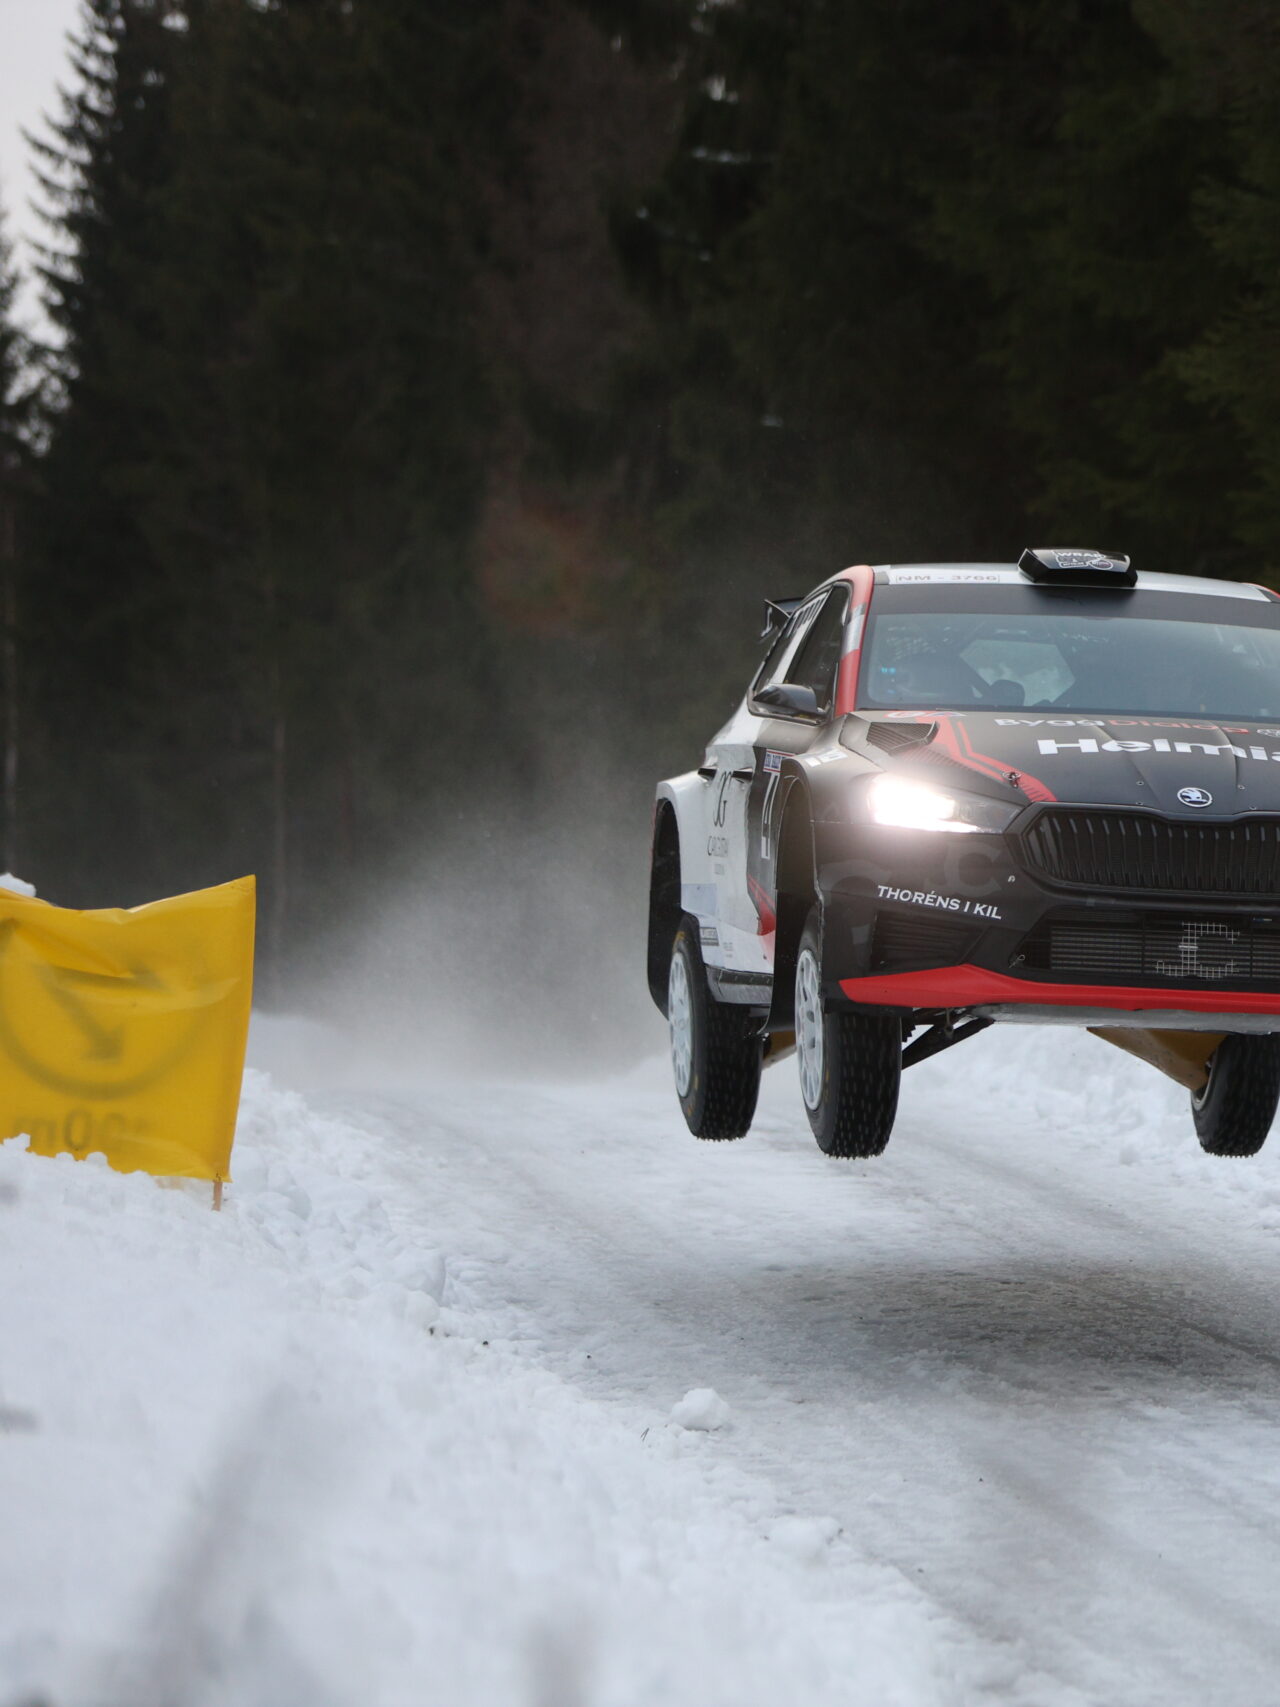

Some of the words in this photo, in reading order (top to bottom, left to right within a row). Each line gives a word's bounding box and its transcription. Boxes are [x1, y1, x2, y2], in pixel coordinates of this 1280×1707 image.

[878, 884, 961, 911] THORÉNS
[963, 901, 971, 913] I
[973, 903, 1002, 920] KIL
